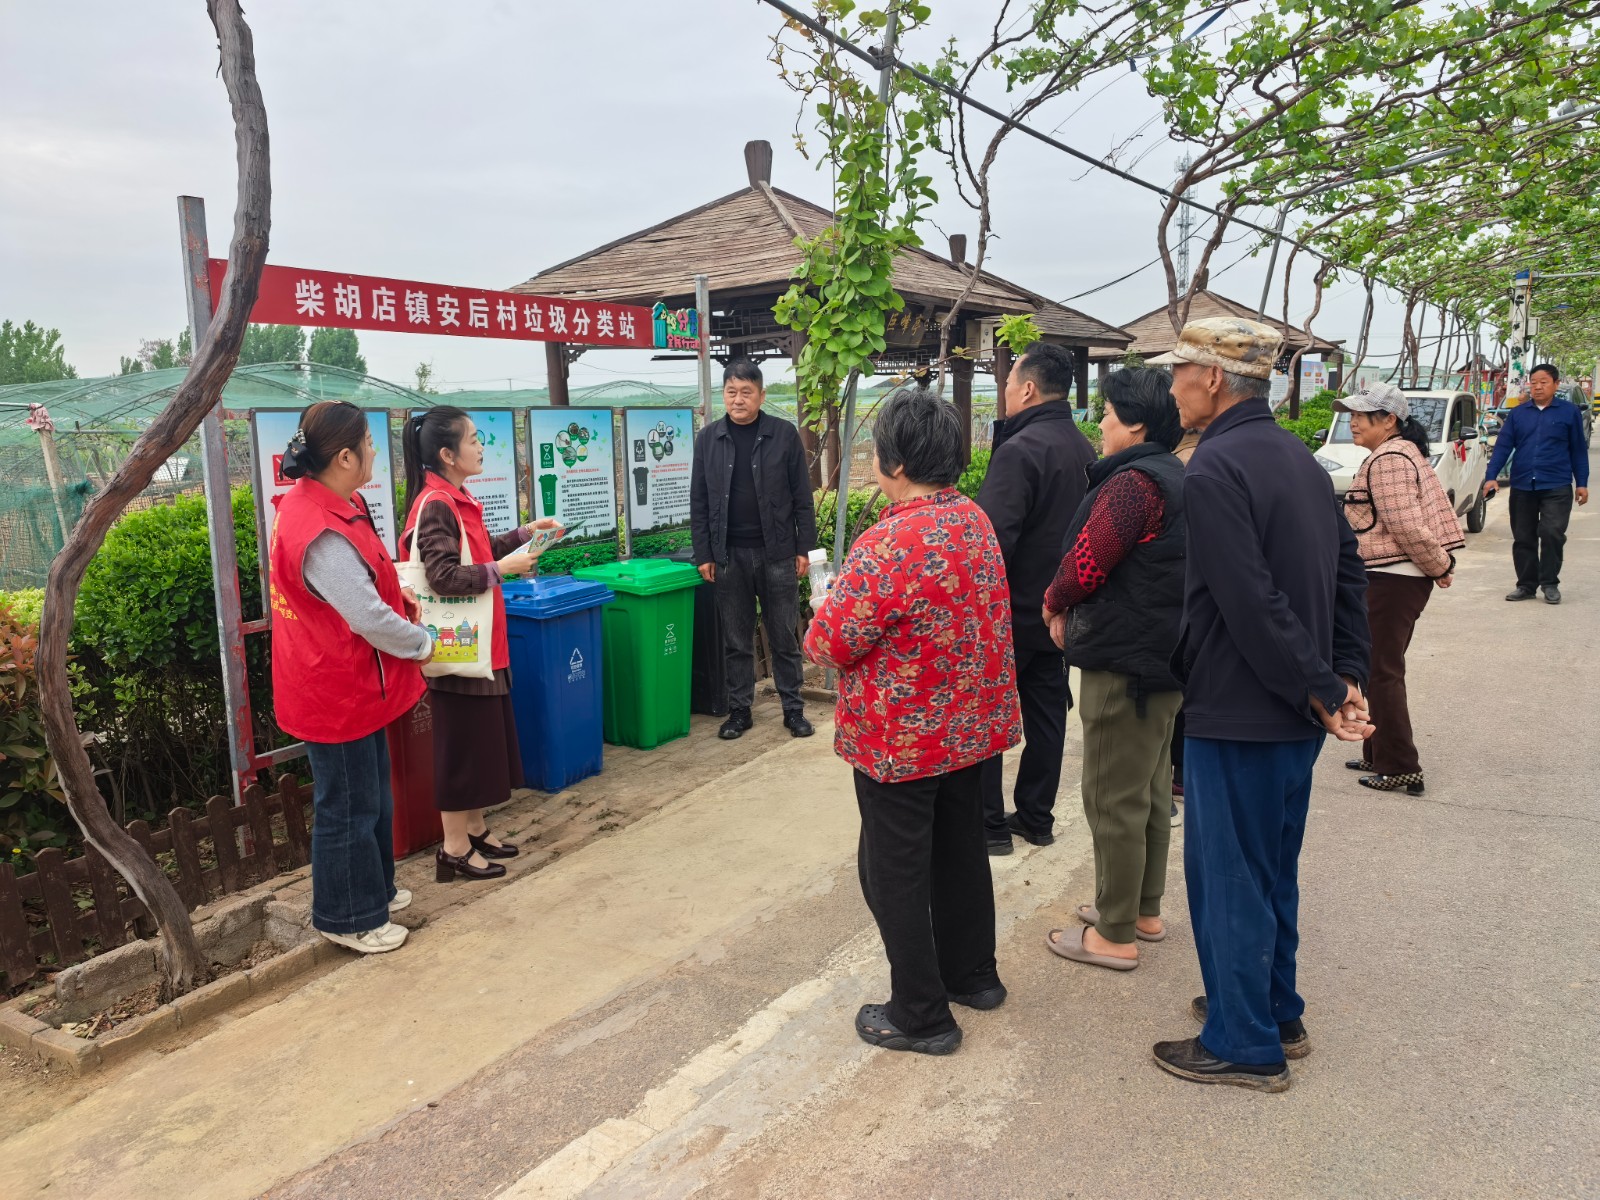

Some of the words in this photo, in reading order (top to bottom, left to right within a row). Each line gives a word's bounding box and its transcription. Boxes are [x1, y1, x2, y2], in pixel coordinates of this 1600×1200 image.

[295, 279, 635, 340] 柴胡店镇安后村垃圾分类站
